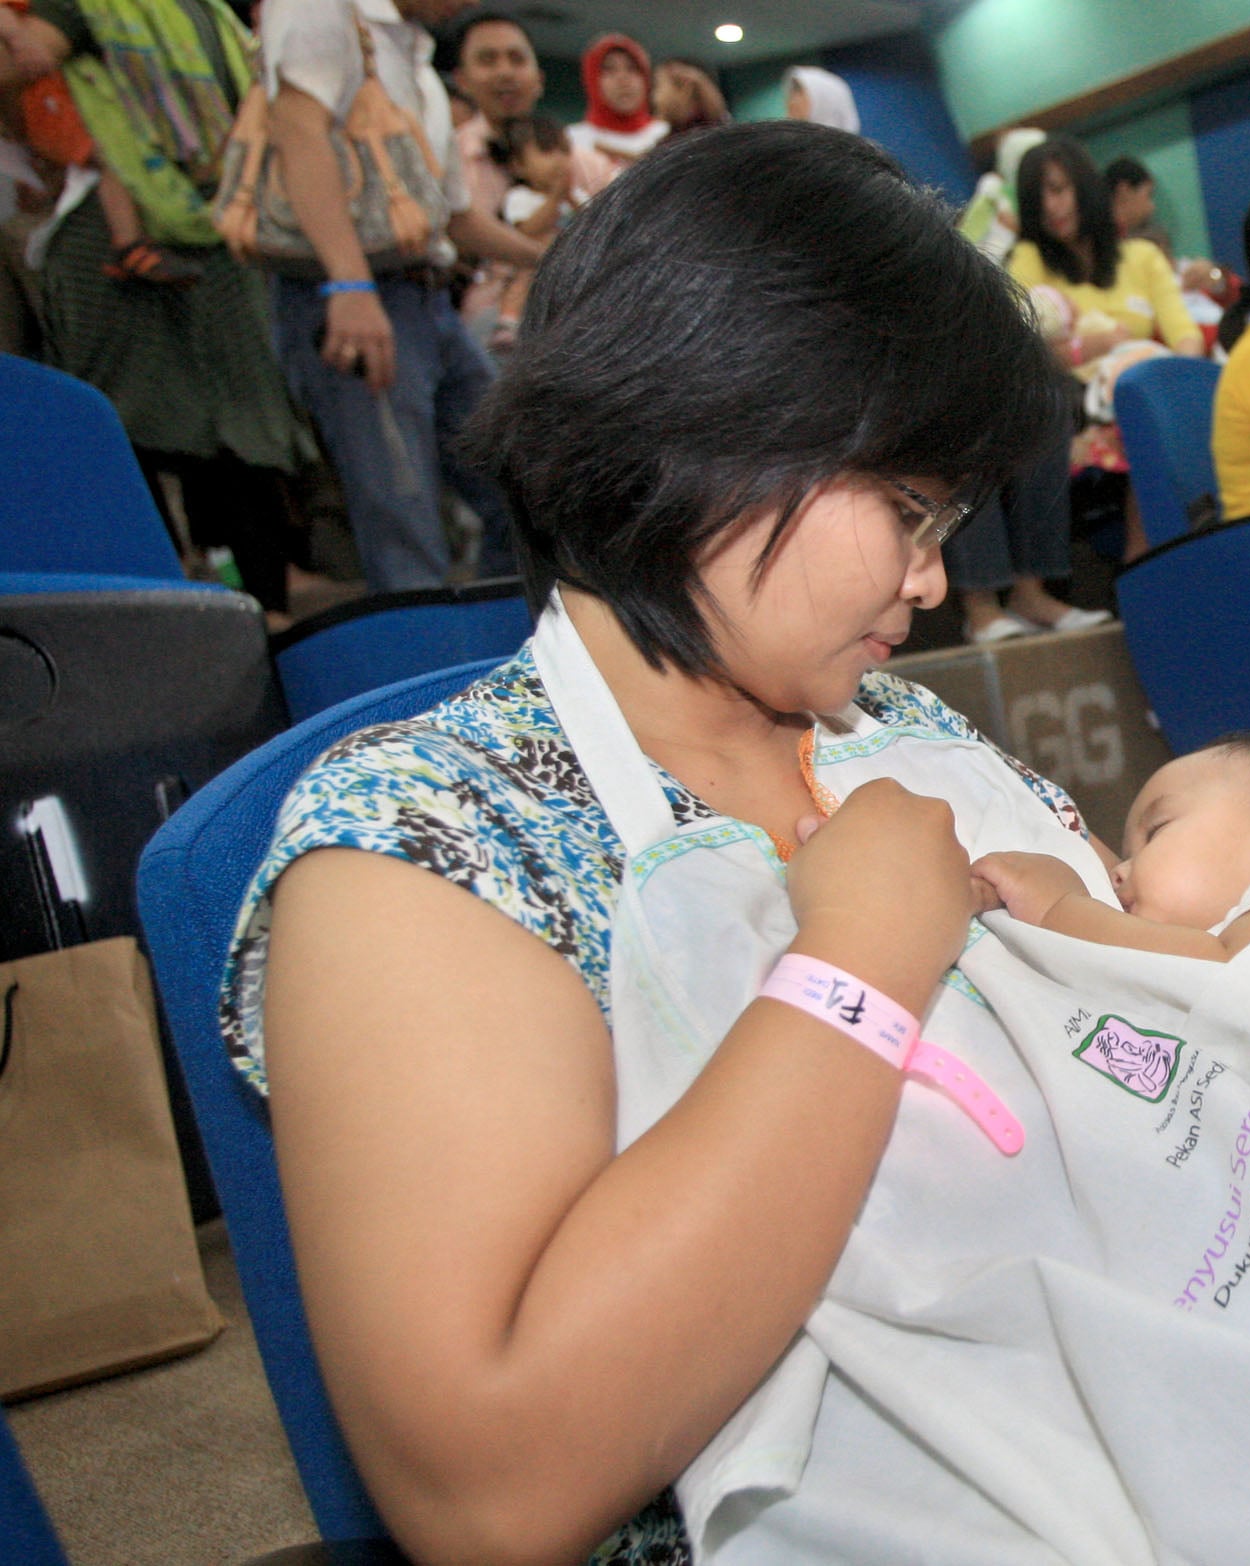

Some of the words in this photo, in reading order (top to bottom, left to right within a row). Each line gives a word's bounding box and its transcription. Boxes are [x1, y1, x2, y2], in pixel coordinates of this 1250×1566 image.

[1012, 682, 1125, 788] GG
[826, 977, 866, 1025] F1
[1165, 1124, 1201, 1169] Pekan
[1189, 1090, 1204, 1121] ASI
